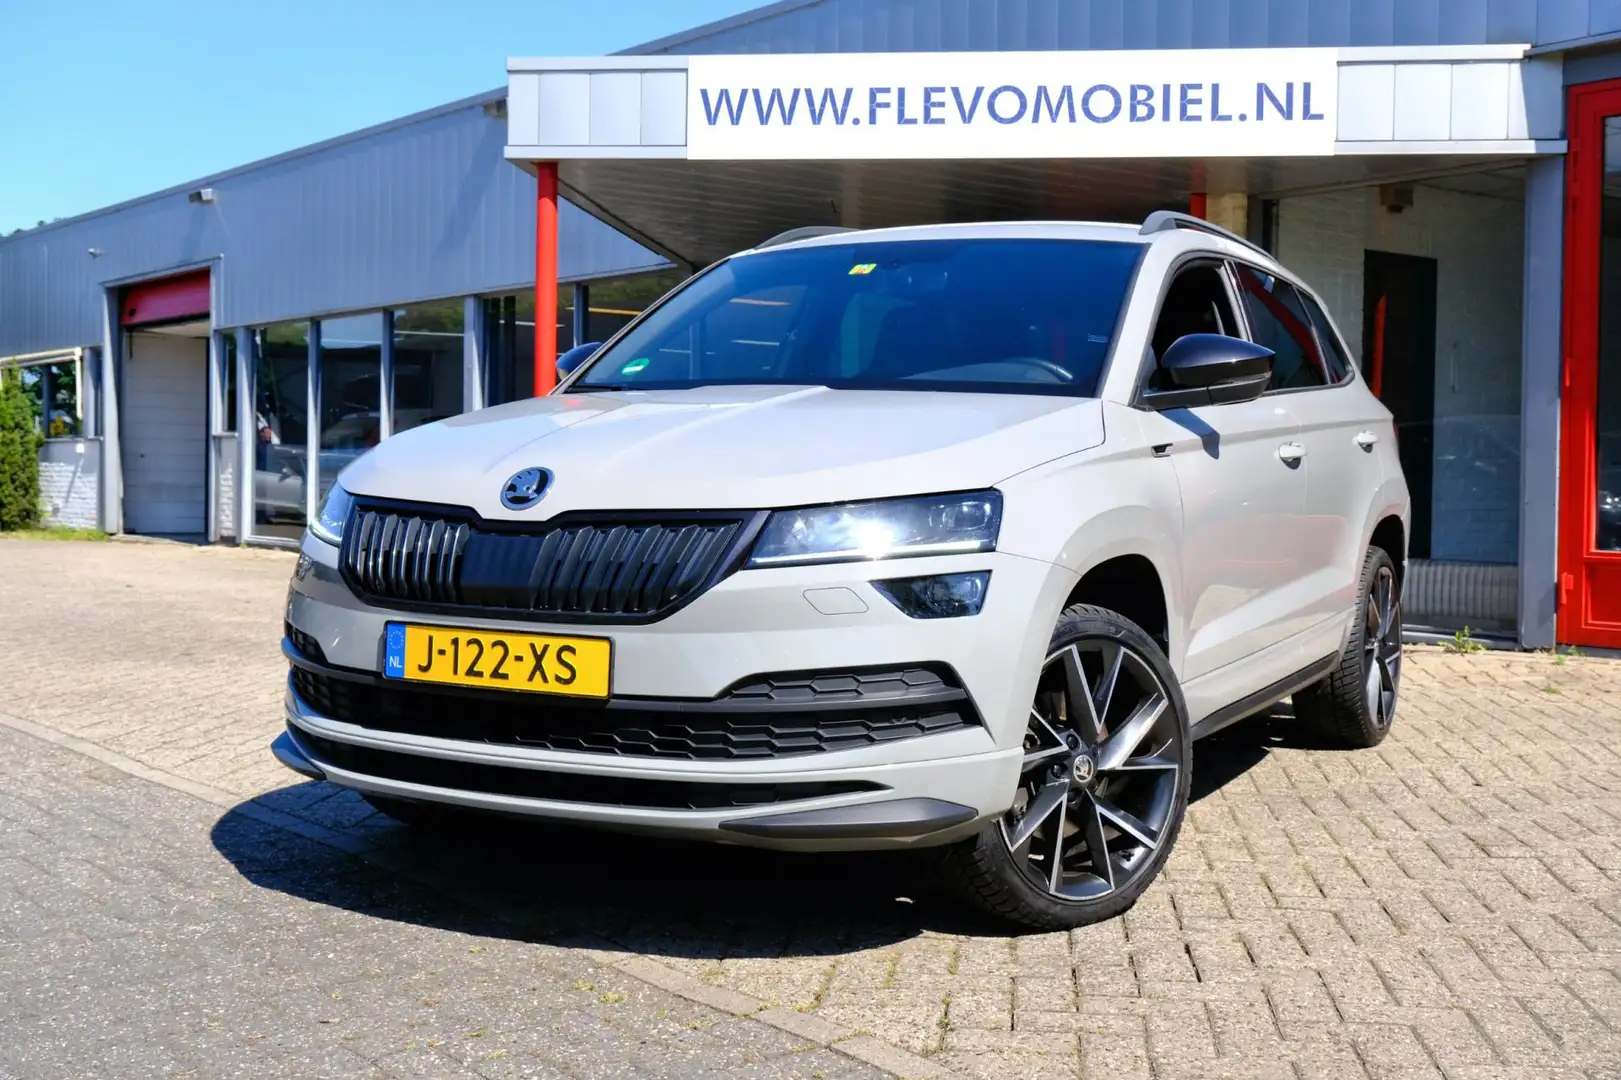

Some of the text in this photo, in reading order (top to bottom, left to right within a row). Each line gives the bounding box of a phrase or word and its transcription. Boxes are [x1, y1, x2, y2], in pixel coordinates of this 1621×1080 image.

[700, 82, 1325, 126] WWW.FLEVOMOBIEL.NL
[389, 656, 403, 668] NL
[418, 634, 577, 685] J-122-XS
